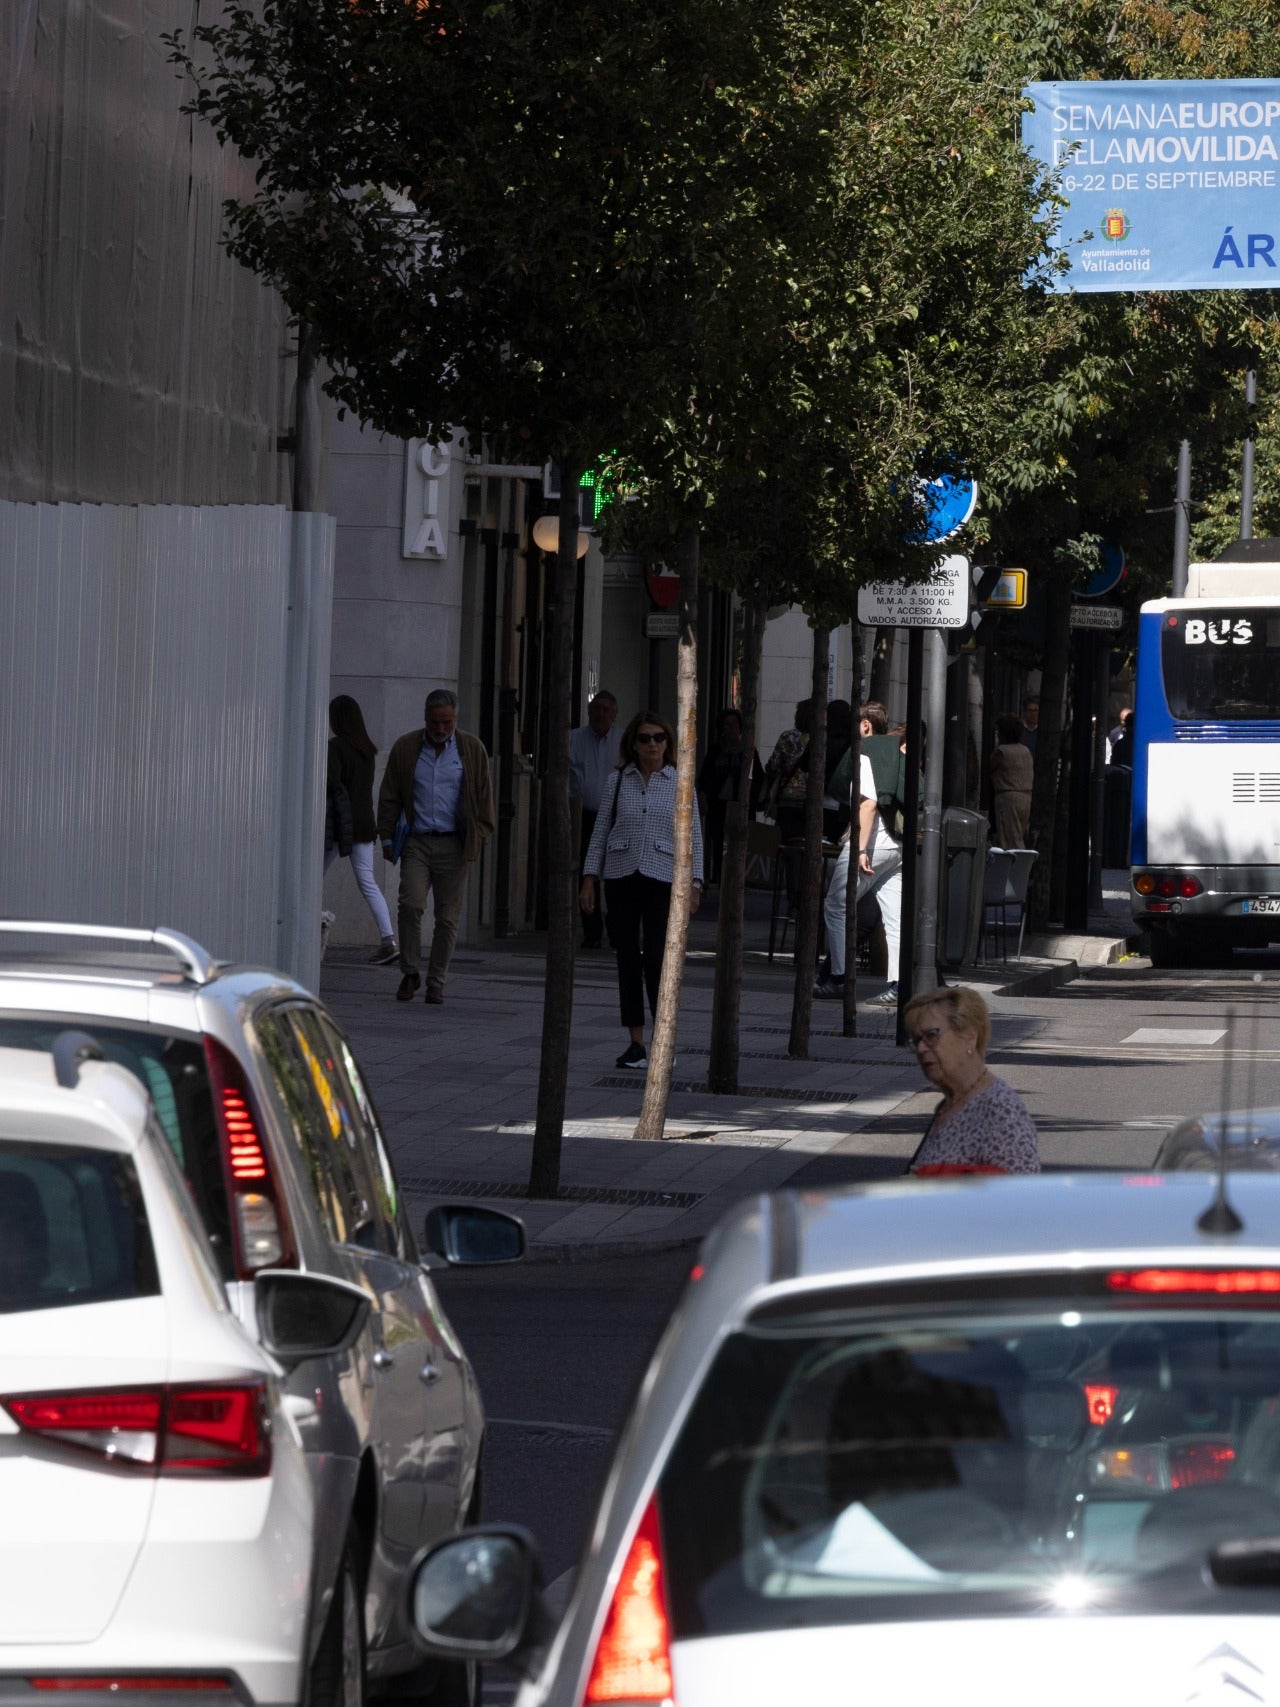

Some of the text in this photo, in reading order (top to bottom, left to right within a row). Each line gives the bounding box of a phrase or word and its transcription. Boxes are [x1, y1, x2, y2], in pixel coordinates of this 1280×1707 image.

[1111, 173, 1140, 191] DE
[1145, 170, 1276, 190] SEPTIEMBRE
[1081, 248, 1151, 259] Ayuntamiento de
[1082, 259, 1151, 272] Valladolid
[872, 588, 955, 597] DE 7:30 A 11:00 H
[876, 597, 906, 605] M.M.A.
[909, 597, 935, 605] 3.500
[887, 606, 943, 616] Y ACCESO A
[868, 616, 961, 625] VADOS AUTORIZADOS
[1184, 618, 1254, 645] BUS
